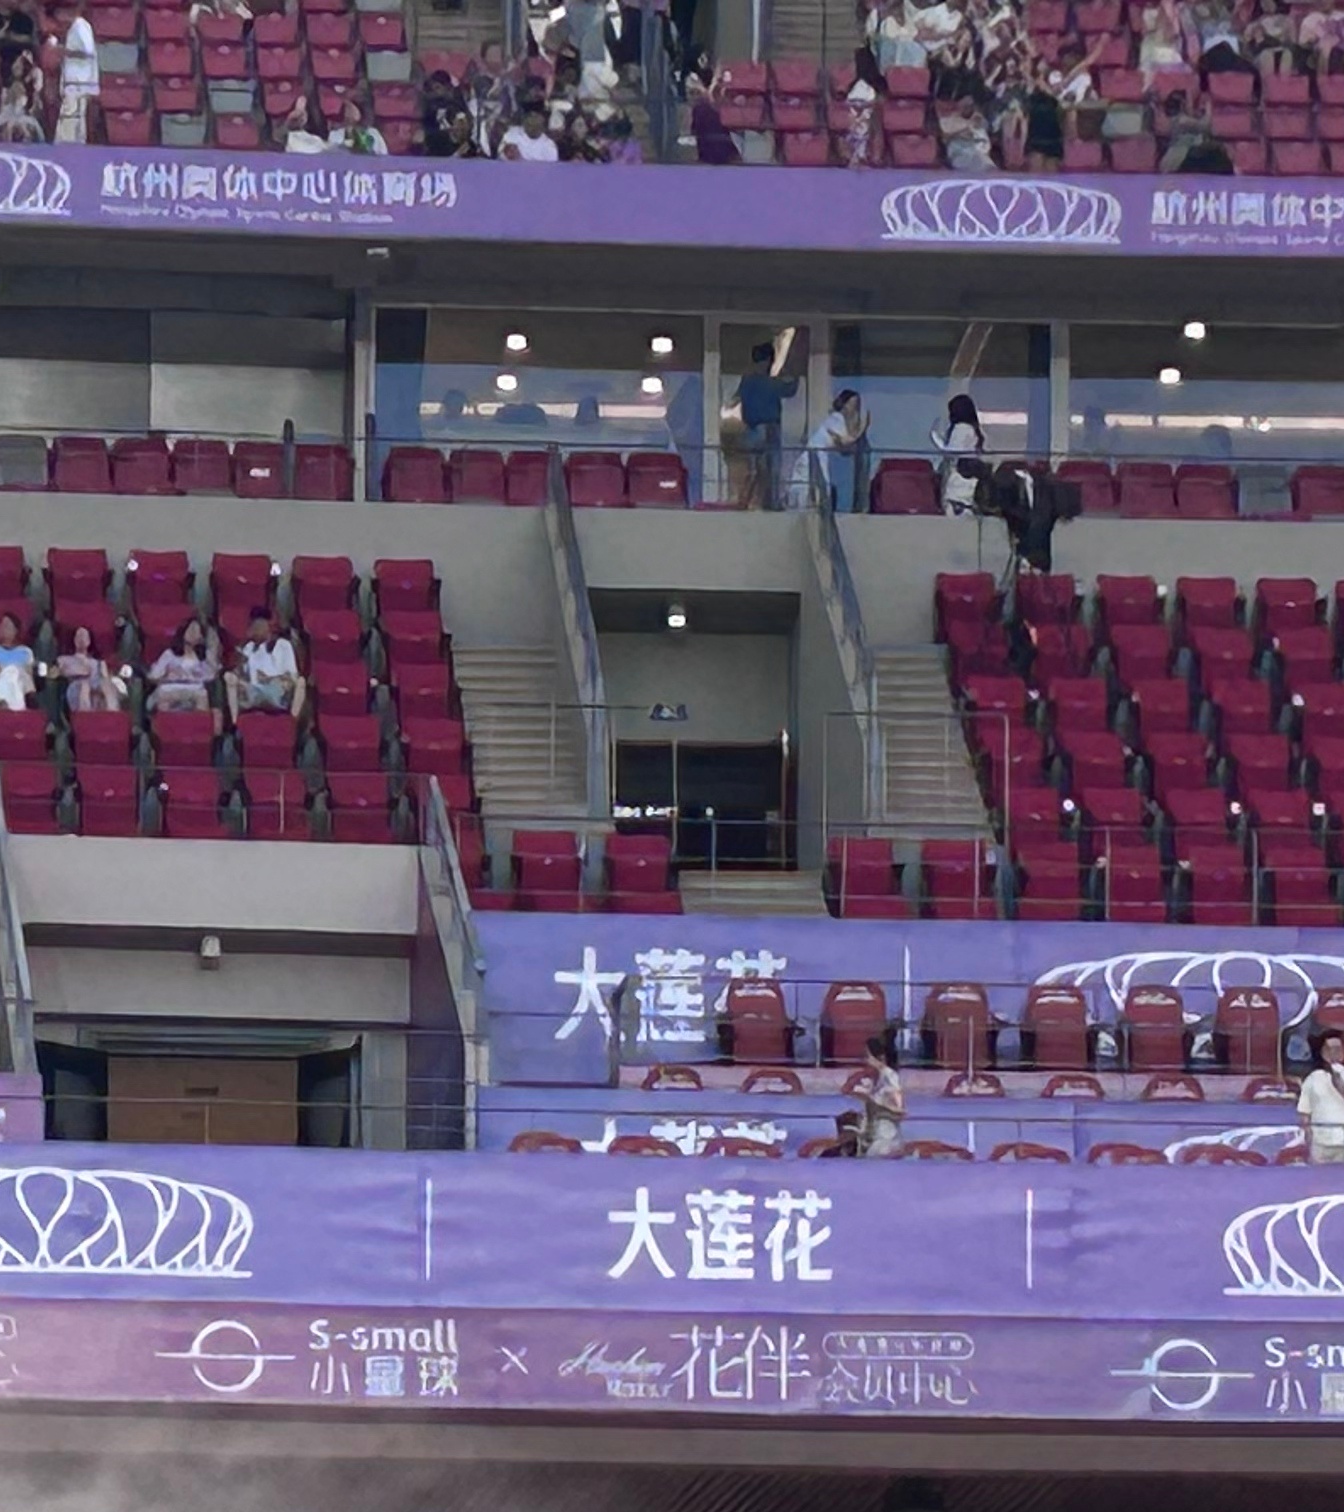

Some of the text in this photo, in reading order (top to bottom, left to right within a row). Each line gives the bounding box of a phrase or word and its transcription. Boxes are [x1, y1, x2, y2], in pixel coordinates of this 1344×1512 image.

[607, 1186, 833, 1282] 大莲花
[309, 1318, 458, 1353] S-small
[669, 1324, 812, 1400] 花伴
